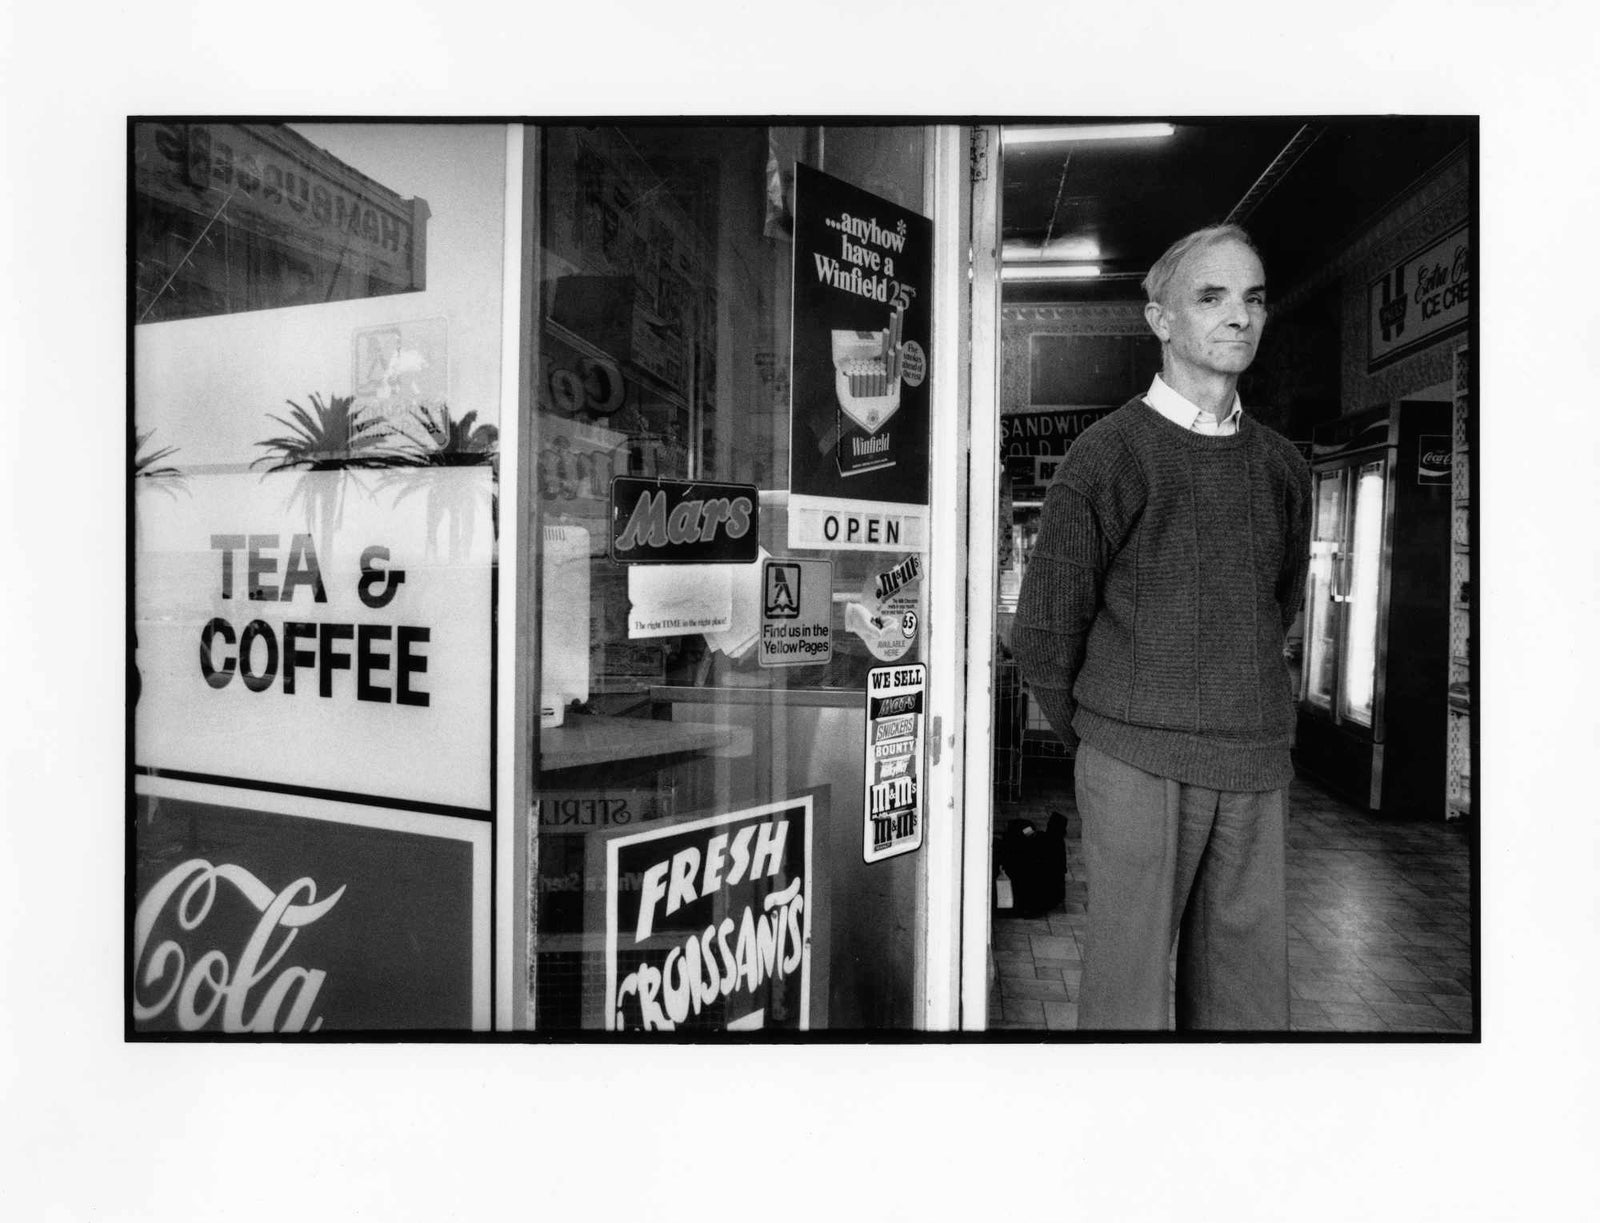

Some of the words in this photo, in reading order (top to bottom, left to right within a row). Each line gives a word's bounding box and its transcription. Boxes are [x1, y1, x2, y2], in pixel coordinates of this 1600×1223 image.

[842, 234, 880, 271] have
[884, 257, 894, 277] a
[813, 252, 887, 302] Winfield
[1422, 293, 1441, 321] ICE
[1001, 413, 1106, 438] SANDWIC
[852, 432, 890, 456] Winfield
[615, 490, 753, 550] Mars
[824, 515, 899, 543] OPEN
[210, 533, 328, 603] TEA
[357, 545, 405, 608] &
[635, 621, 646, 629] The
[647, 621, 661, 630] right
[662, 619, 680, 628] TIME
[698, 618, 711, 627] right
[764, 624, 787, 637] Find
[788, 626, 800, 637] us
[802, 624, 811, 637] in
[813, 624, 829, 637] the
[764, 639, 798, 654] Yellow
[799, 640, 829, 655] Pages
[200, 617, 431, 707] COFFEE
[872, 672, 891, 689] WE
[894, 669, 922, 688] SELL
[879, 695, 916, 717] Mars
[877, 717, 914, 740] SNICKERS
[875, 741, 915, 758] BOUNTY
[635, 820, 790, 943] FRESH
[133, 858, 347, 1033] Cola
